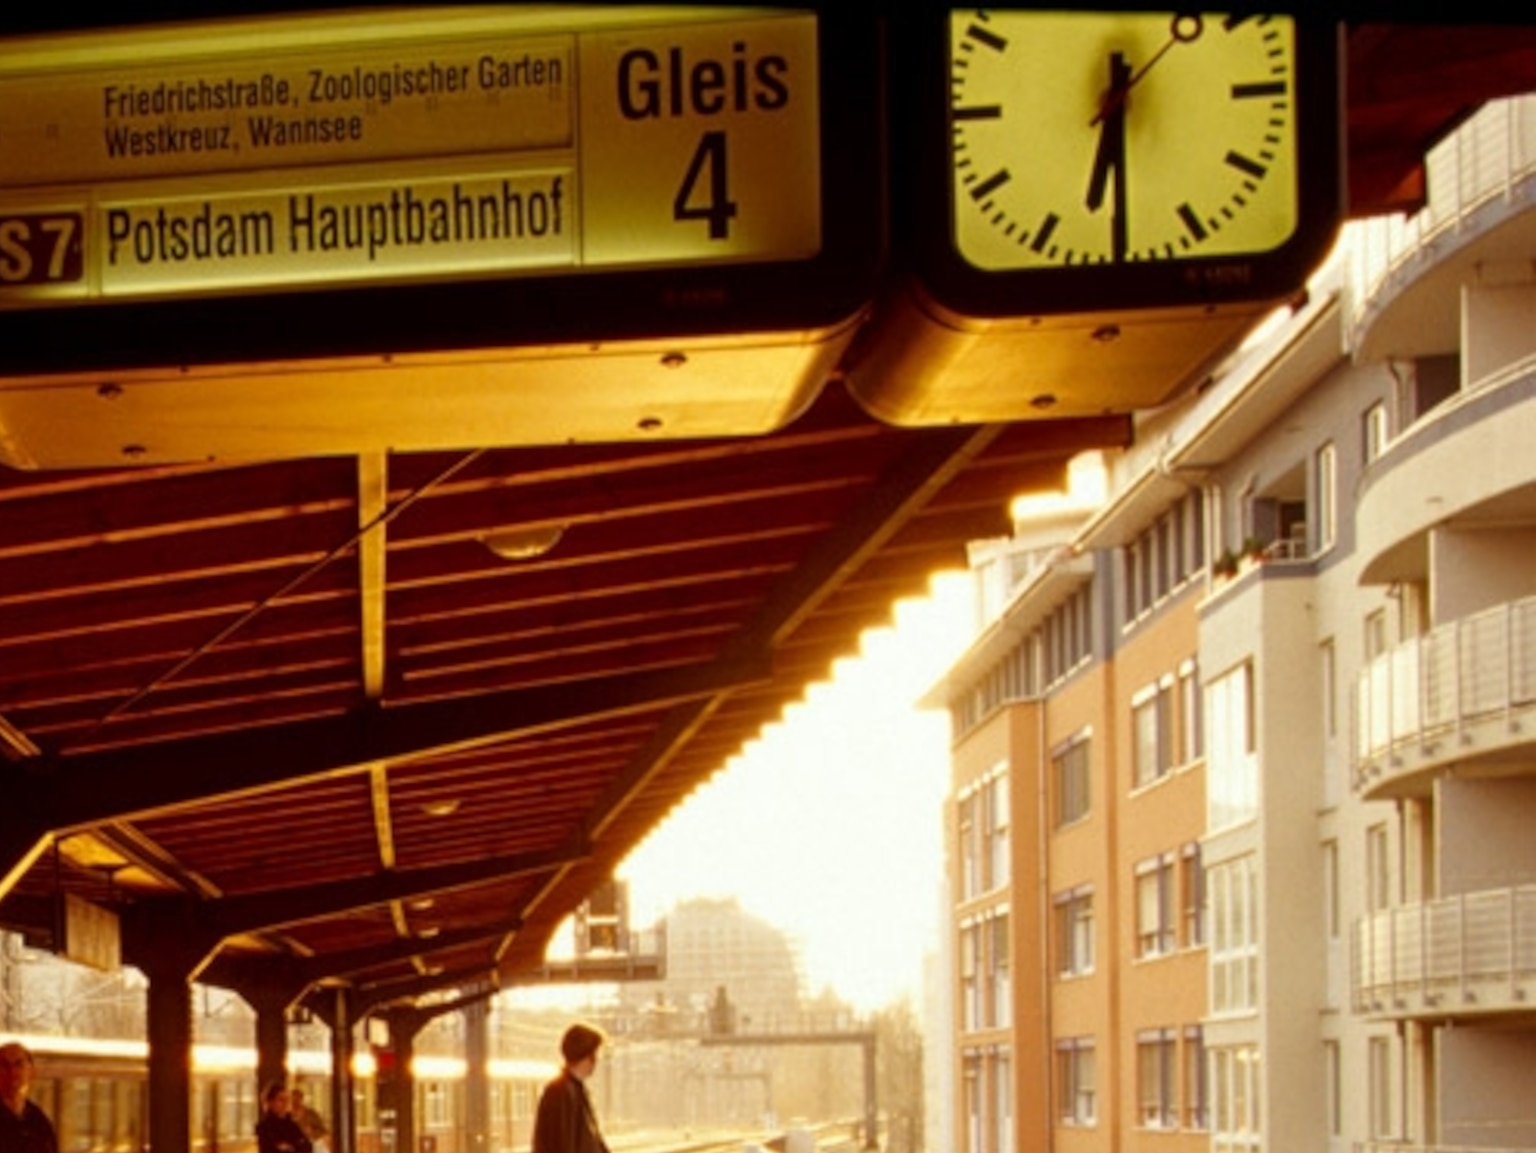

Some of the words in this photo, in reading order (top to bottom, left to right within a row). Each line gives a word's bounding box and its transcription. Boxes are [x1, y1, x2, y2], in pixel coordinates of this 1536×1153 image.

[104, 74, 299, 119] Friedrichstraße,
[308, 59, 469, 105] Zoologischer
[478, 54, 562, 90] Garten
[617, 41, 789, 121] Gleis
[105, 122, 240, 158] Westkreuz,
[248, 114, 362, 147] Wannsee
[108, 202, 274, 266] Potsdam
[288, 175, 562, 261] Hauptbahnhof
[673, 130, 738, 240] 4
